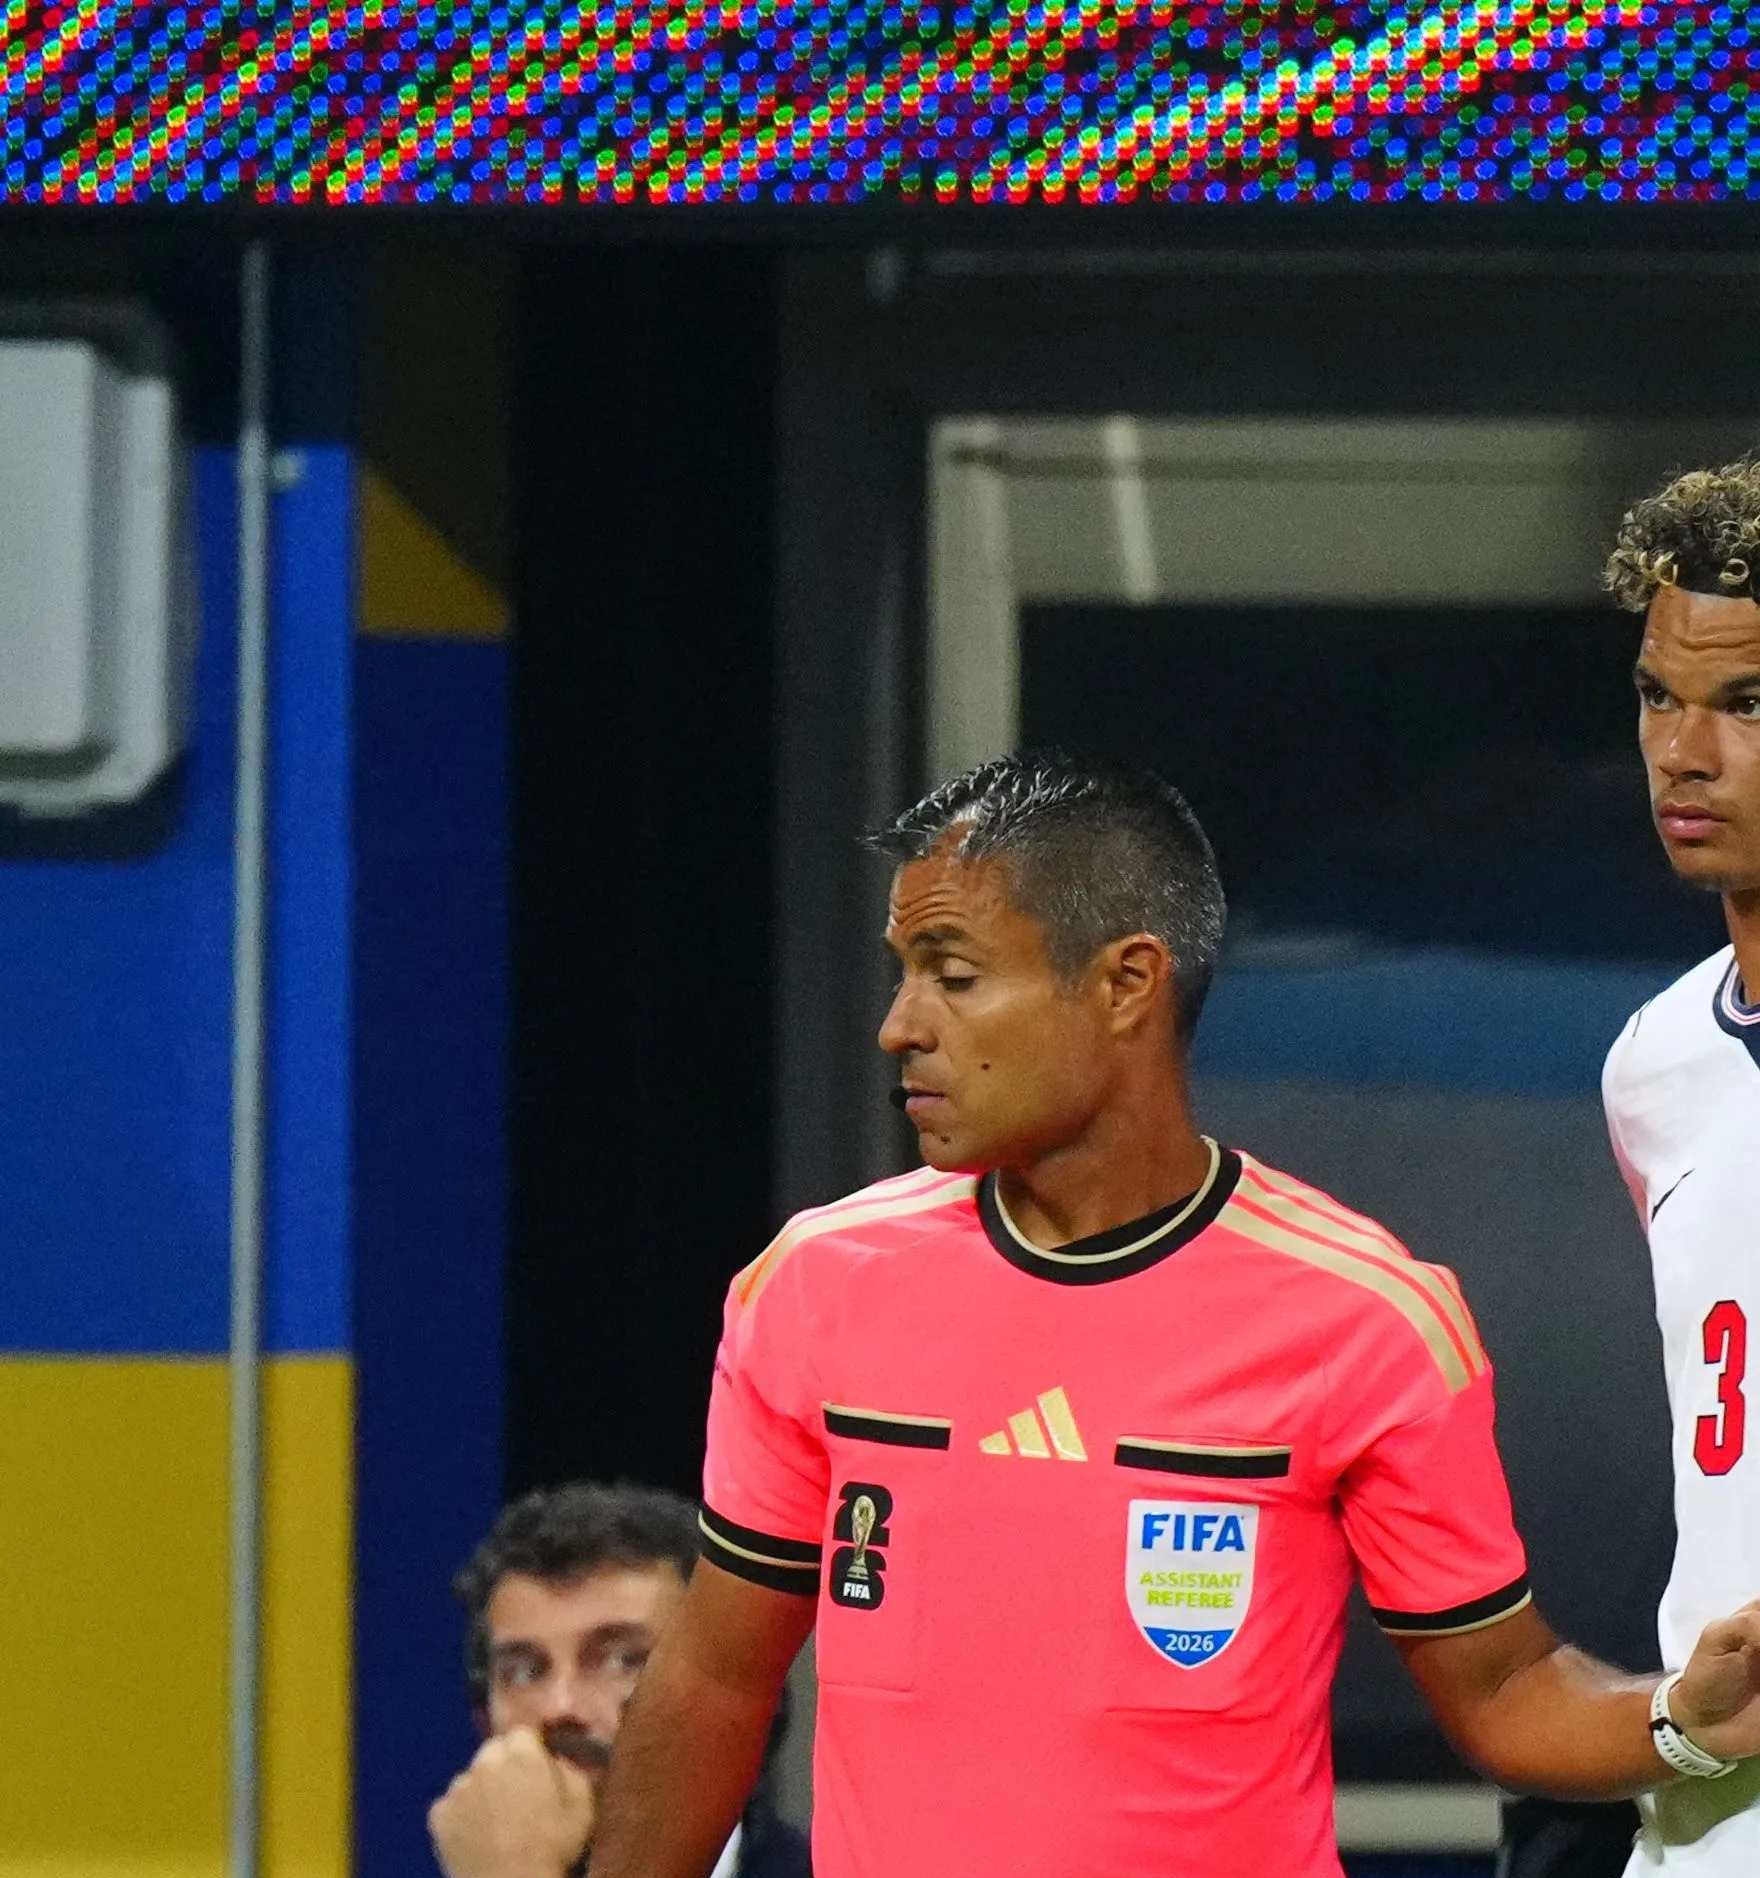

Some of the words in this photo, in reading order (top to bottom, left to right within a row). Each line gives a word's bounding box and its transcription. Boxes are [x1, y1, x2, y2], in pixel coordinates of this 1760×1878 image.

[1694, 1299, 1747, 1477] 3
[1141, 1513, 1246, 1552] FIFA
[1140, 1570, 1243, 1589] ASSISTANT
[842, 1581, 872, 1600] FIFA
[1146, 1589, 1234, 1609] REFEREE
[1165, 1633, 1215, 1653] 2026
